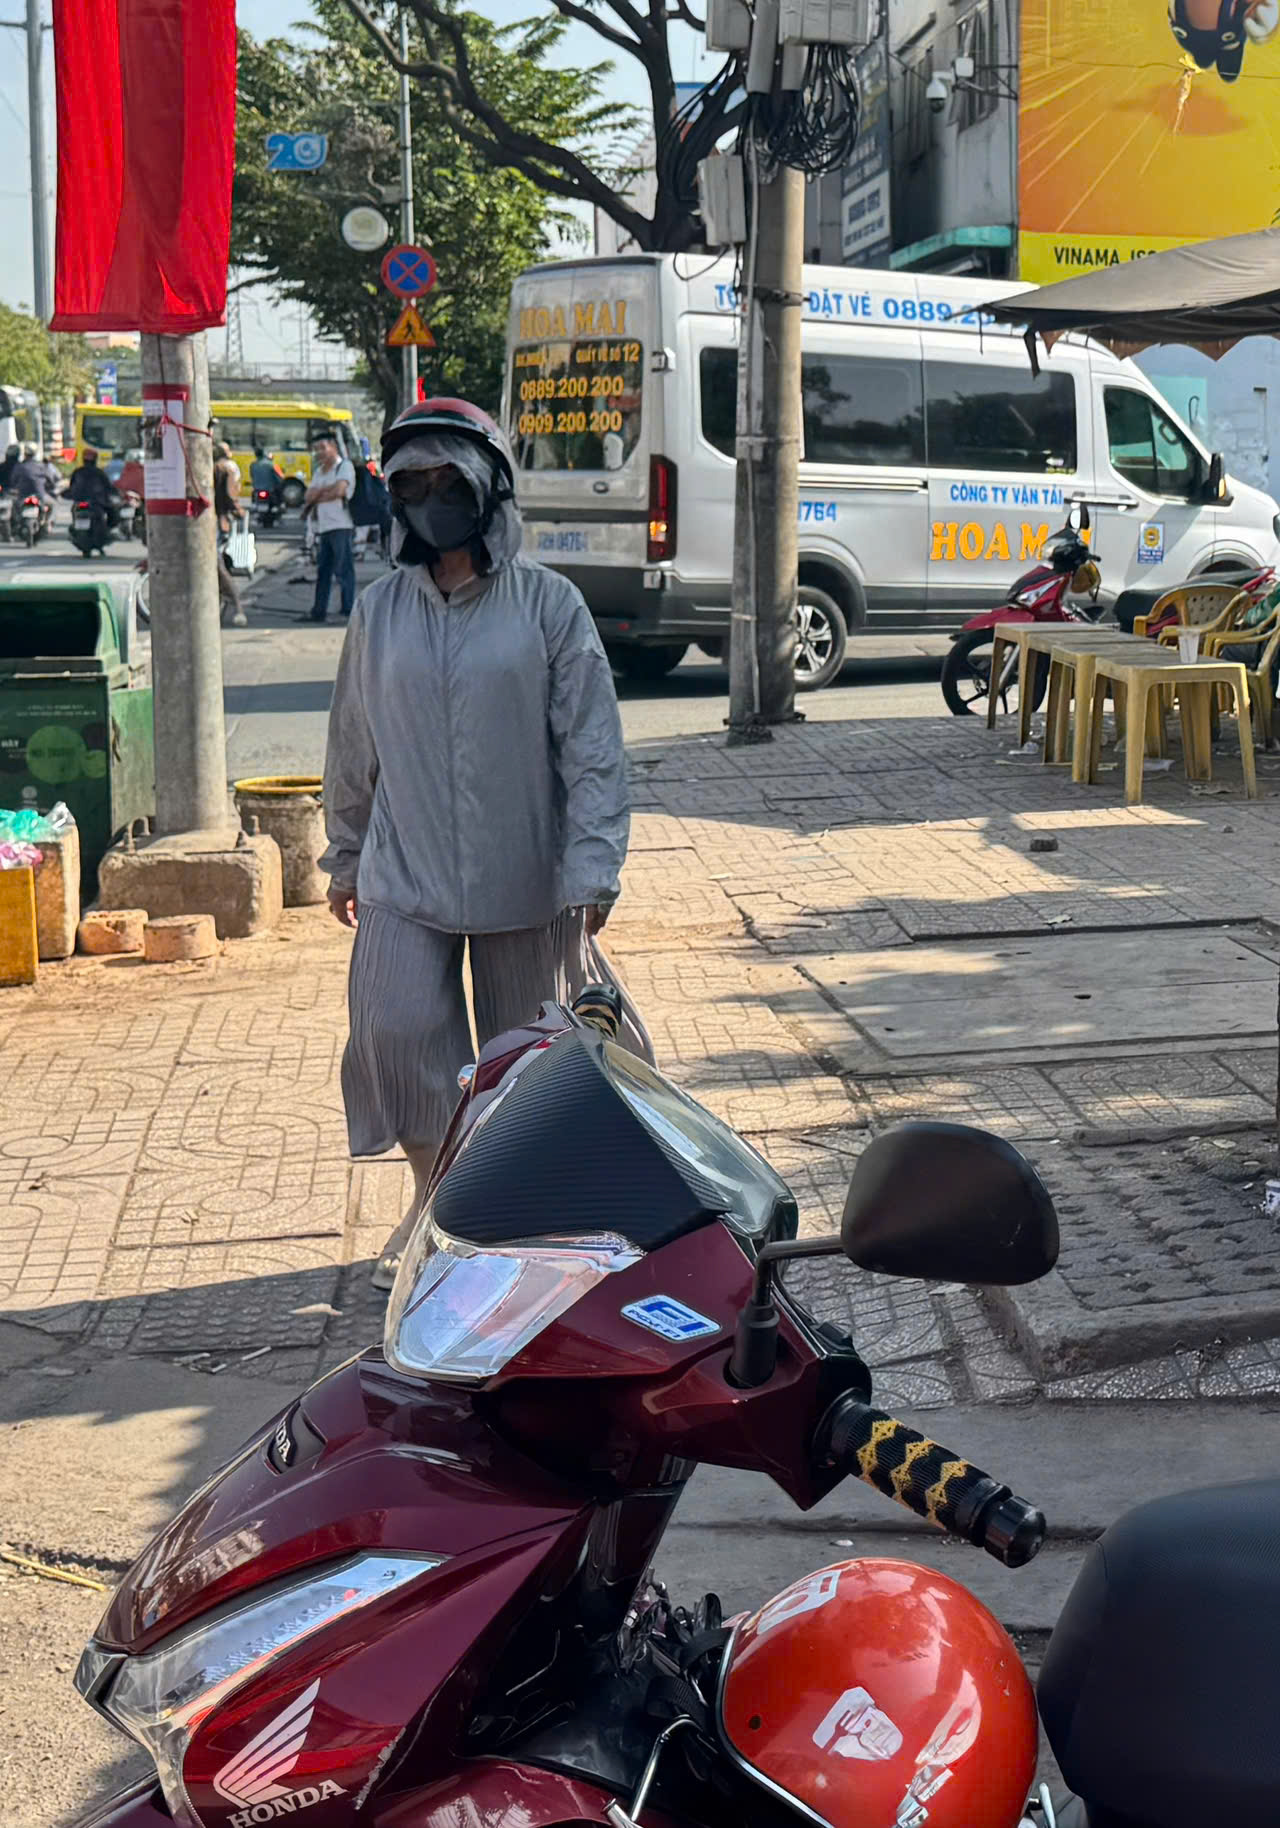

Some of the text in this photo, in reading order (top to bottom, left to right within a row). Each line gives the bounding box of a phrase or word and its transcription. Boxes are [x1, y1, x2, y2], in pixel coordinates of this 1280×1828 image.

[1054, 246, 1119, 266] VINAMA
[520, 301, 626, 337] HOA MAI
[623, 342, 640, 362] 12
[520, 376, 624, 400] 0889.200.200
[518, 410, 622, 433] 0909.200.200
[950, 480, 988, 501] CÔNG
[991, 487, 1008, 502] TY
[930, 522, 1010, 560] HOA
[226, 1780, 348, 1828] HONDA
